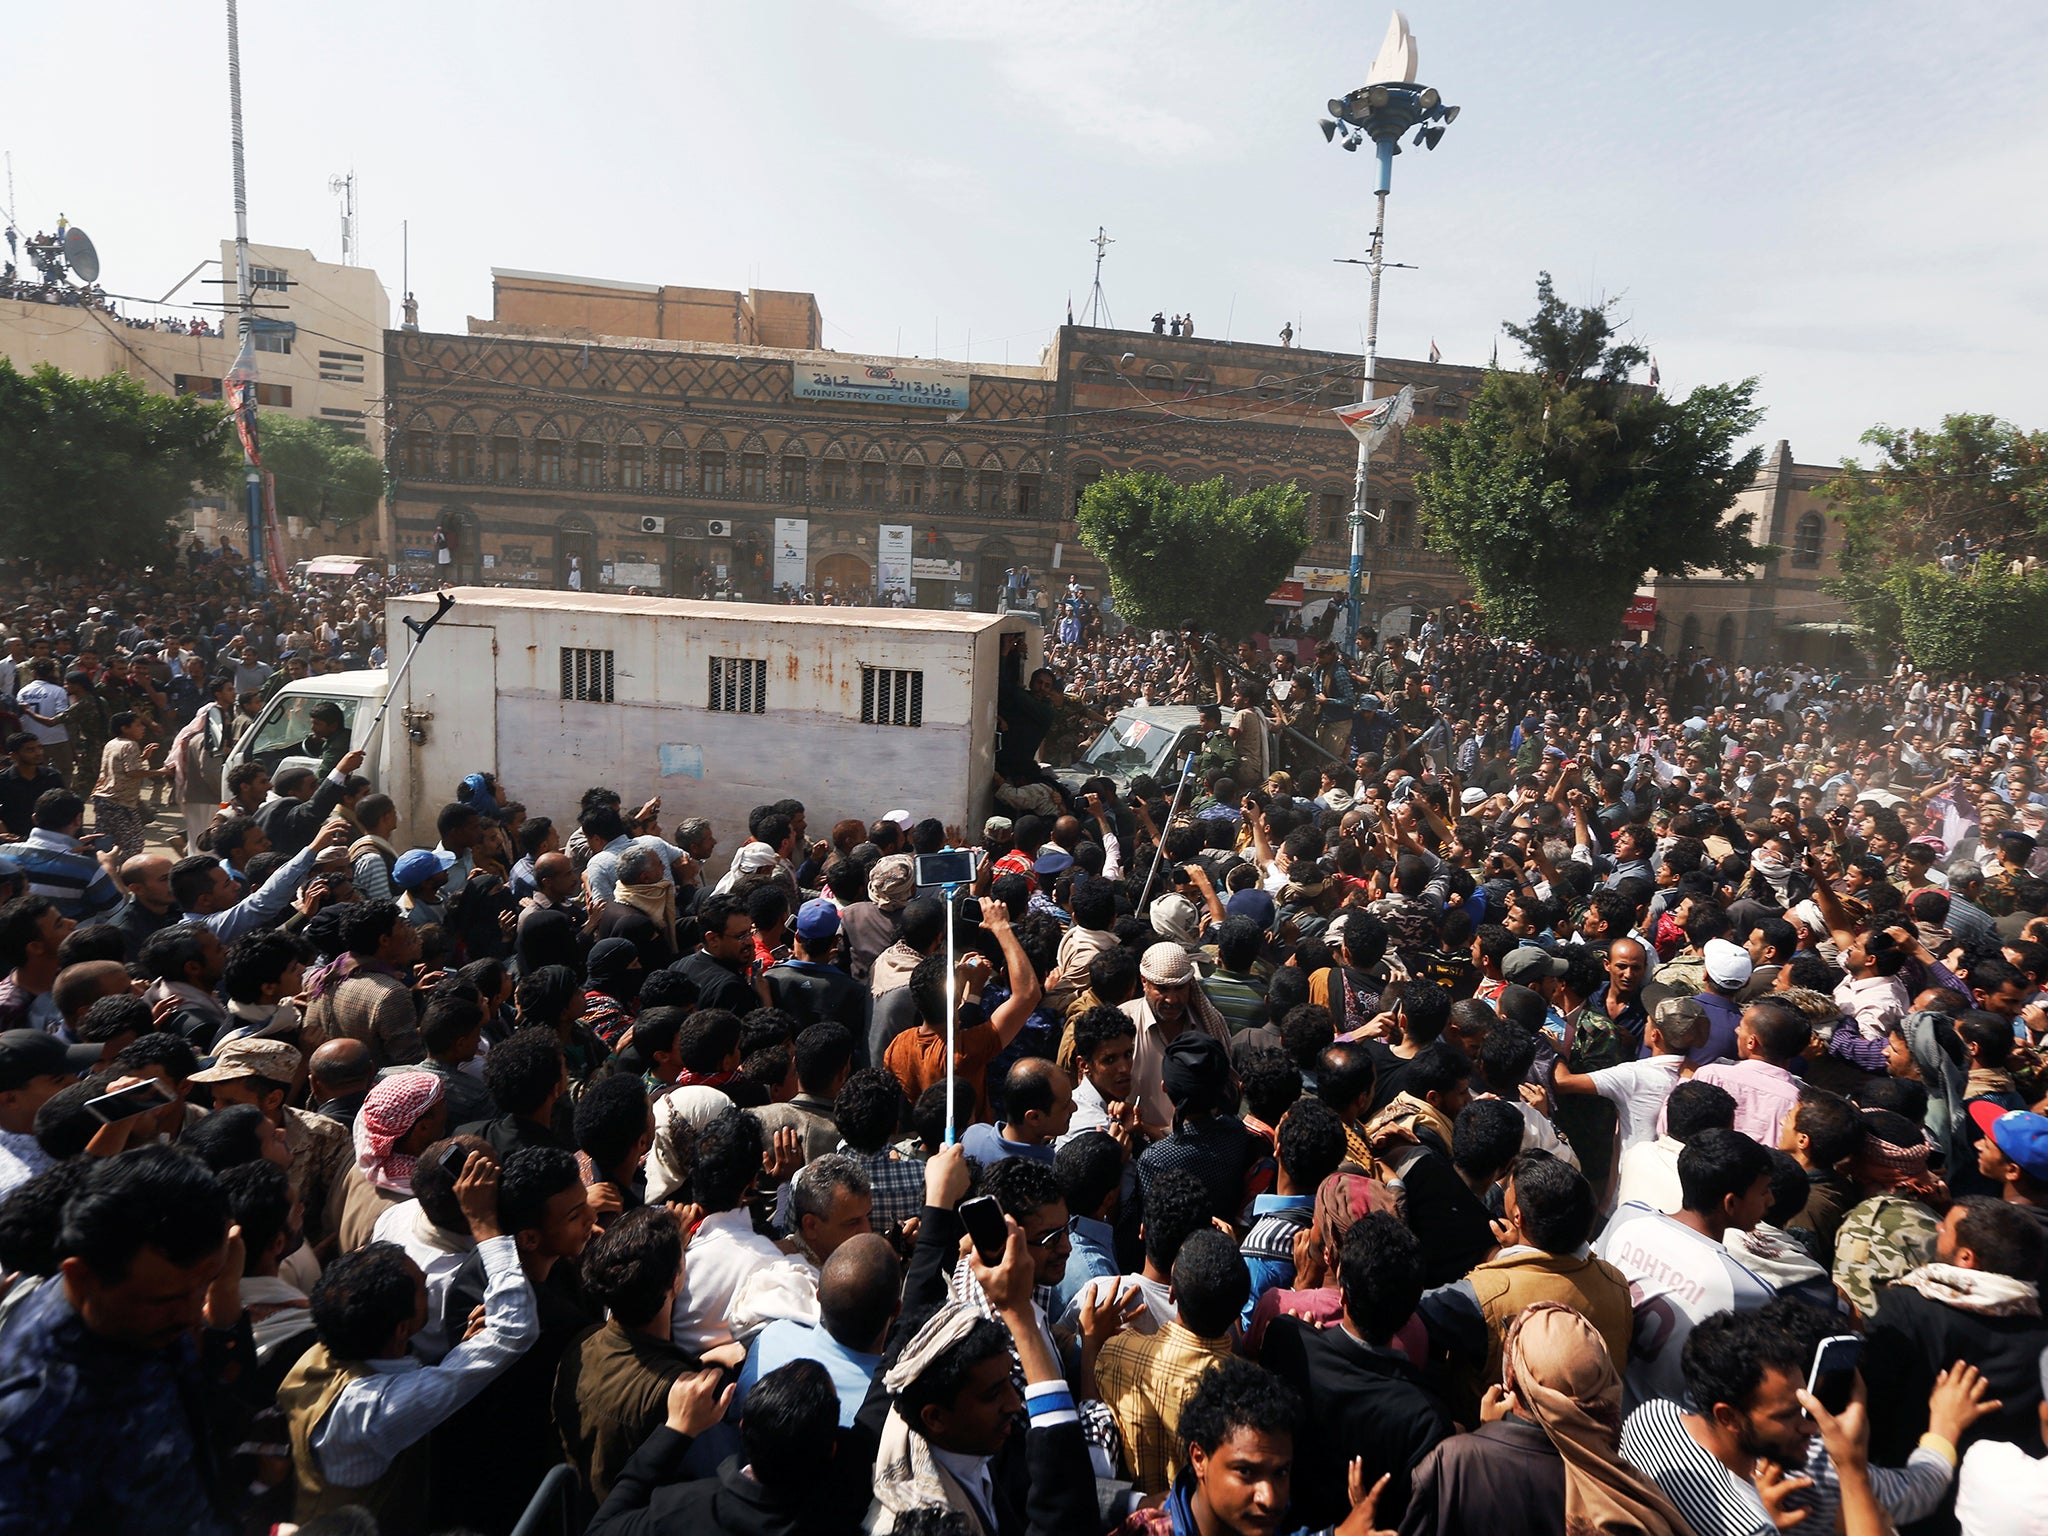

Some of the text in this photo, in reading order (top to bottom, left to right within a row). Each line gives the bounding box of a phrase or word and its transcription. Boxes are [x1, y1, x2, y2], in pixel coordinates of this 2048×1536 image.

[802, 388, 960, 407] MINISTRY OF CULTURE
[914, 380, 951, 397] وزارة
